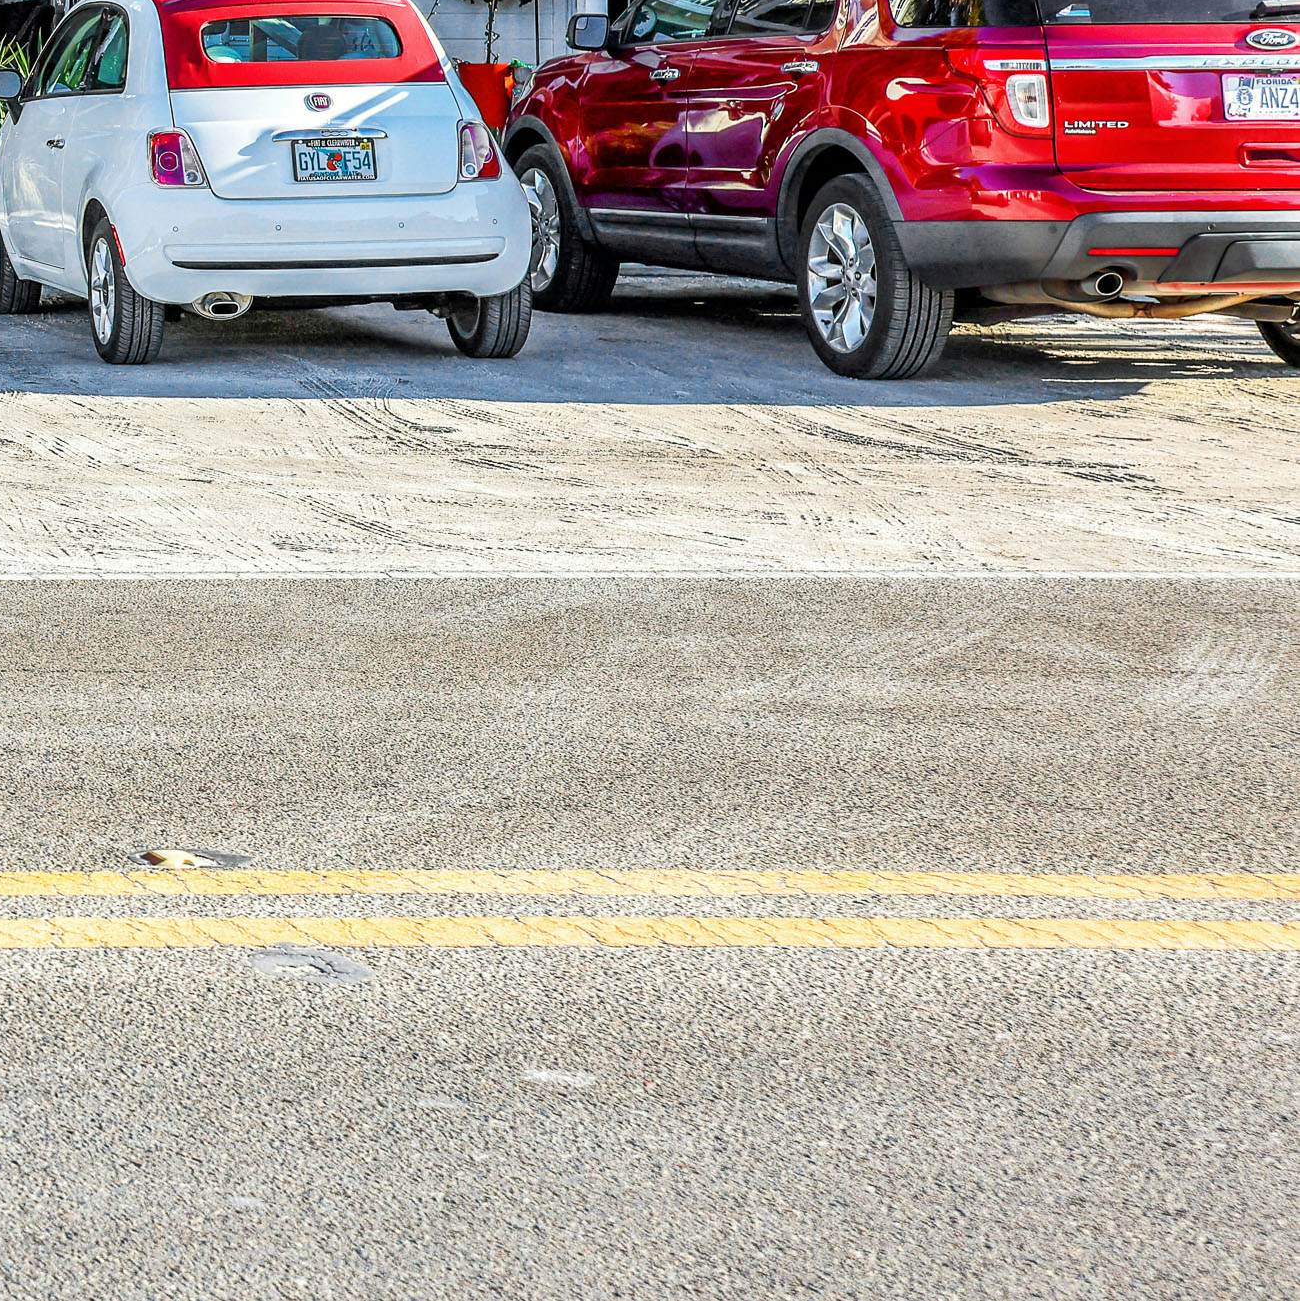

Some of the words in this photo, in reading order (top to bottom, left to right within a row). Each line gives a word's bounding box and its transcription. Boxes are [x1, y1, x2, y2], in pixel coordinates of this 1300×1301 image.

[1260, 32, 1289, 45] Ford
[313, 96, 328, 106] FIAT
[1064, 120, 1129, 129] LIMITED
[298, 151, 327, 171] GYL
[343, 151, 371, 170] F54
